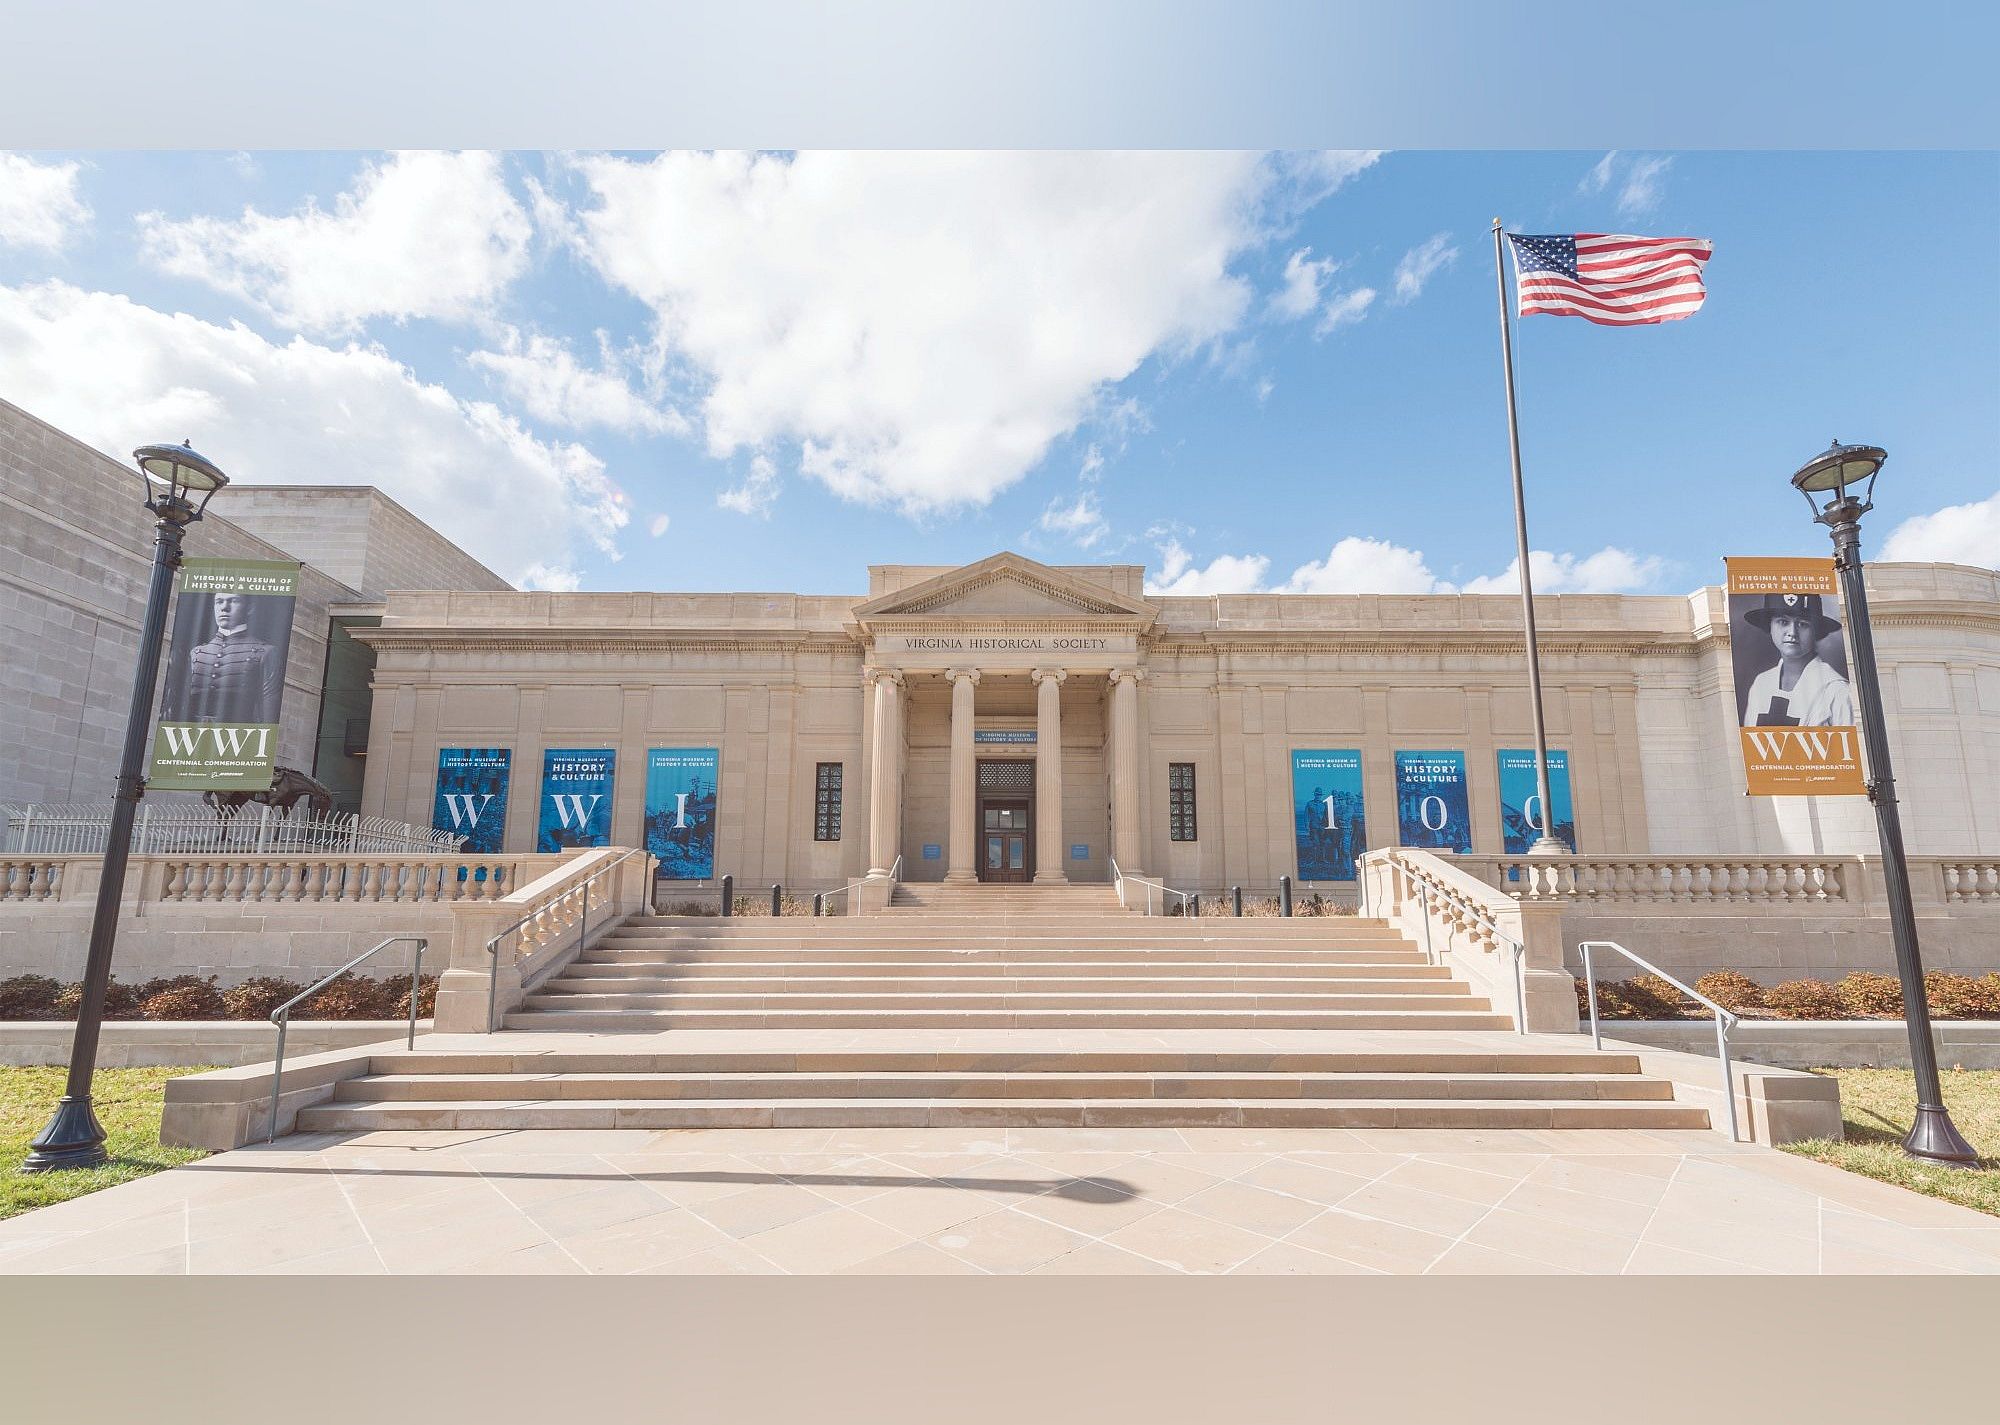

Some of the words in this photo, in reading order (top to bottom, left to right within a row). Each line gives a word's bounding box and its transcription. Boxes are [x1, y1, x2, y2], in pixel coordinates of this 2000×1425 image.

[191, 582, 235, 590] HISTORY
[248, 584, 291, 592] CULTURE
[193, 574, 235, 582] VIRGINIA
[238, 576, 276, 584] MUSEUM
[905, 638, 963, 649] VIRGINIA
[969, 638, 1044, 649] HISTORICAL
[1052, 638, 1107, 649] SOCIETY
[161, 726, 271, 758] WWI
[1745, 731, 1854, 761] WWI
[553, 763, 605, 771] HISTORY
[1405, 765, 1456, 773] HISTORY
[442, 794, 496, 829] W
[550, 794, 604, 829] W
[673, 793, 690, 828] I
[1322, 795, 1339, 830] 1
[1421, 796, 1447, 830] 0
